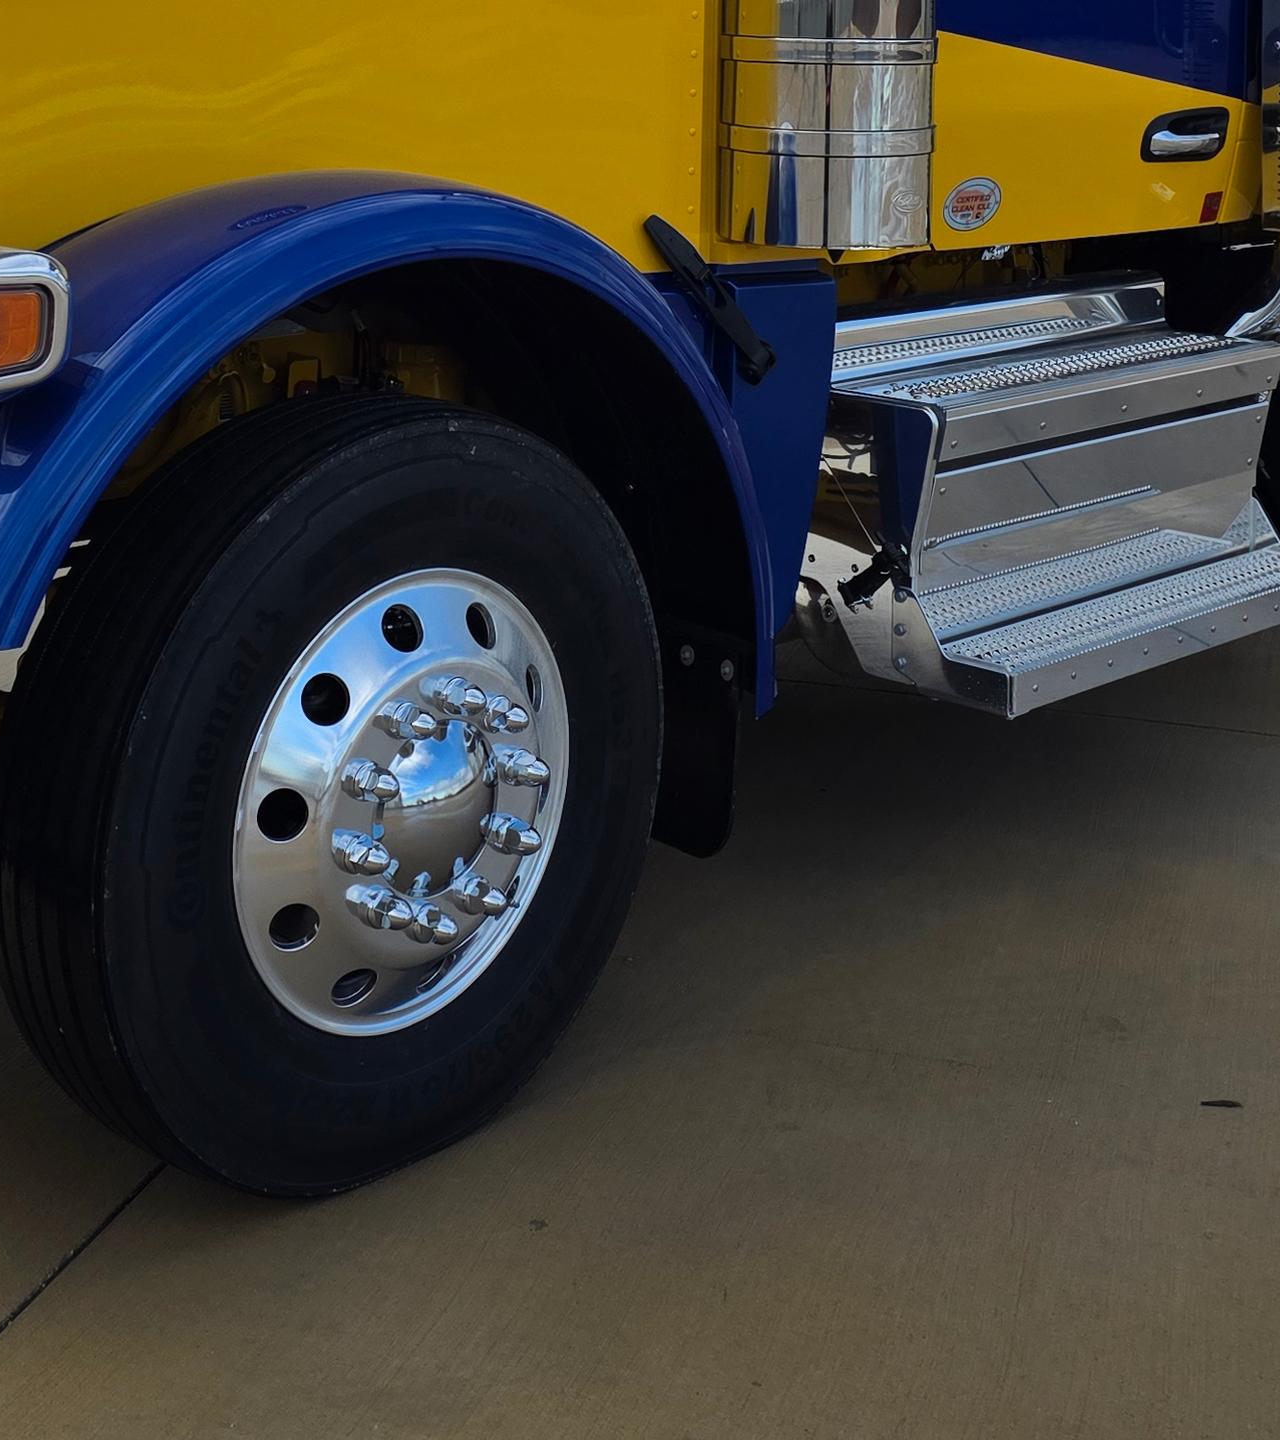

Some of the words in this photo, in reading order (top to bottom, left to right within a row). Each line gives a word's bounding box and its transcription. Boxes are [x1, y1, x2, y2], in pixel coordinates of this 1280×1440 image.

[956, 194, 991, 204] CERTIFIED
[951, 204, 975, 213] CLEAN
[168, 634, 263, 933] Continental
